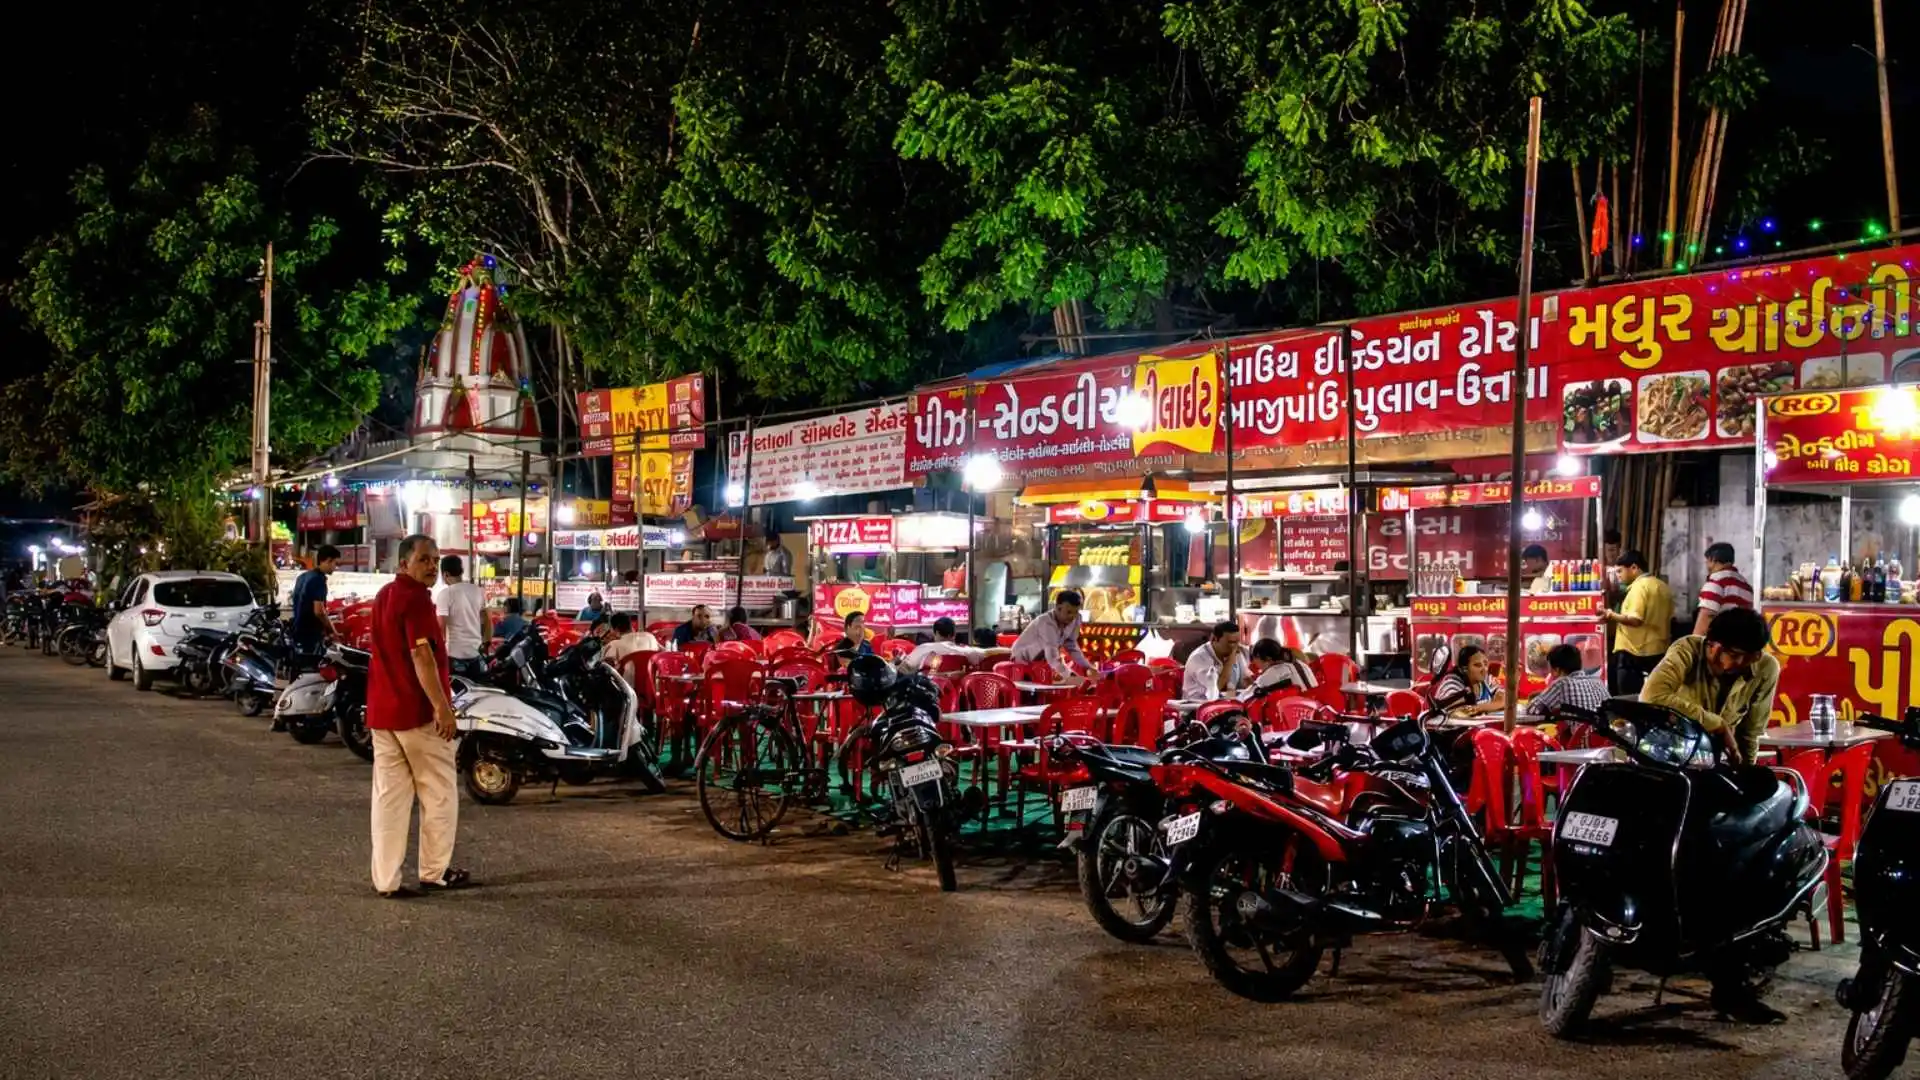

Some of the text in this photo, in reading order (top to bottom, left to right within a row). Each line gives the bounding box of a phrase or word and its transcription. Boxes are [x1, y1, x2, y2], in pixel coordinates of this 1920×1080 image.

[1568, 294, 1693, 370] મધુર
[1780, 397, 1825, 413] RG
[814, 521, 861, 544] PIZZA
[1777, 617, 1823, 648] RG
